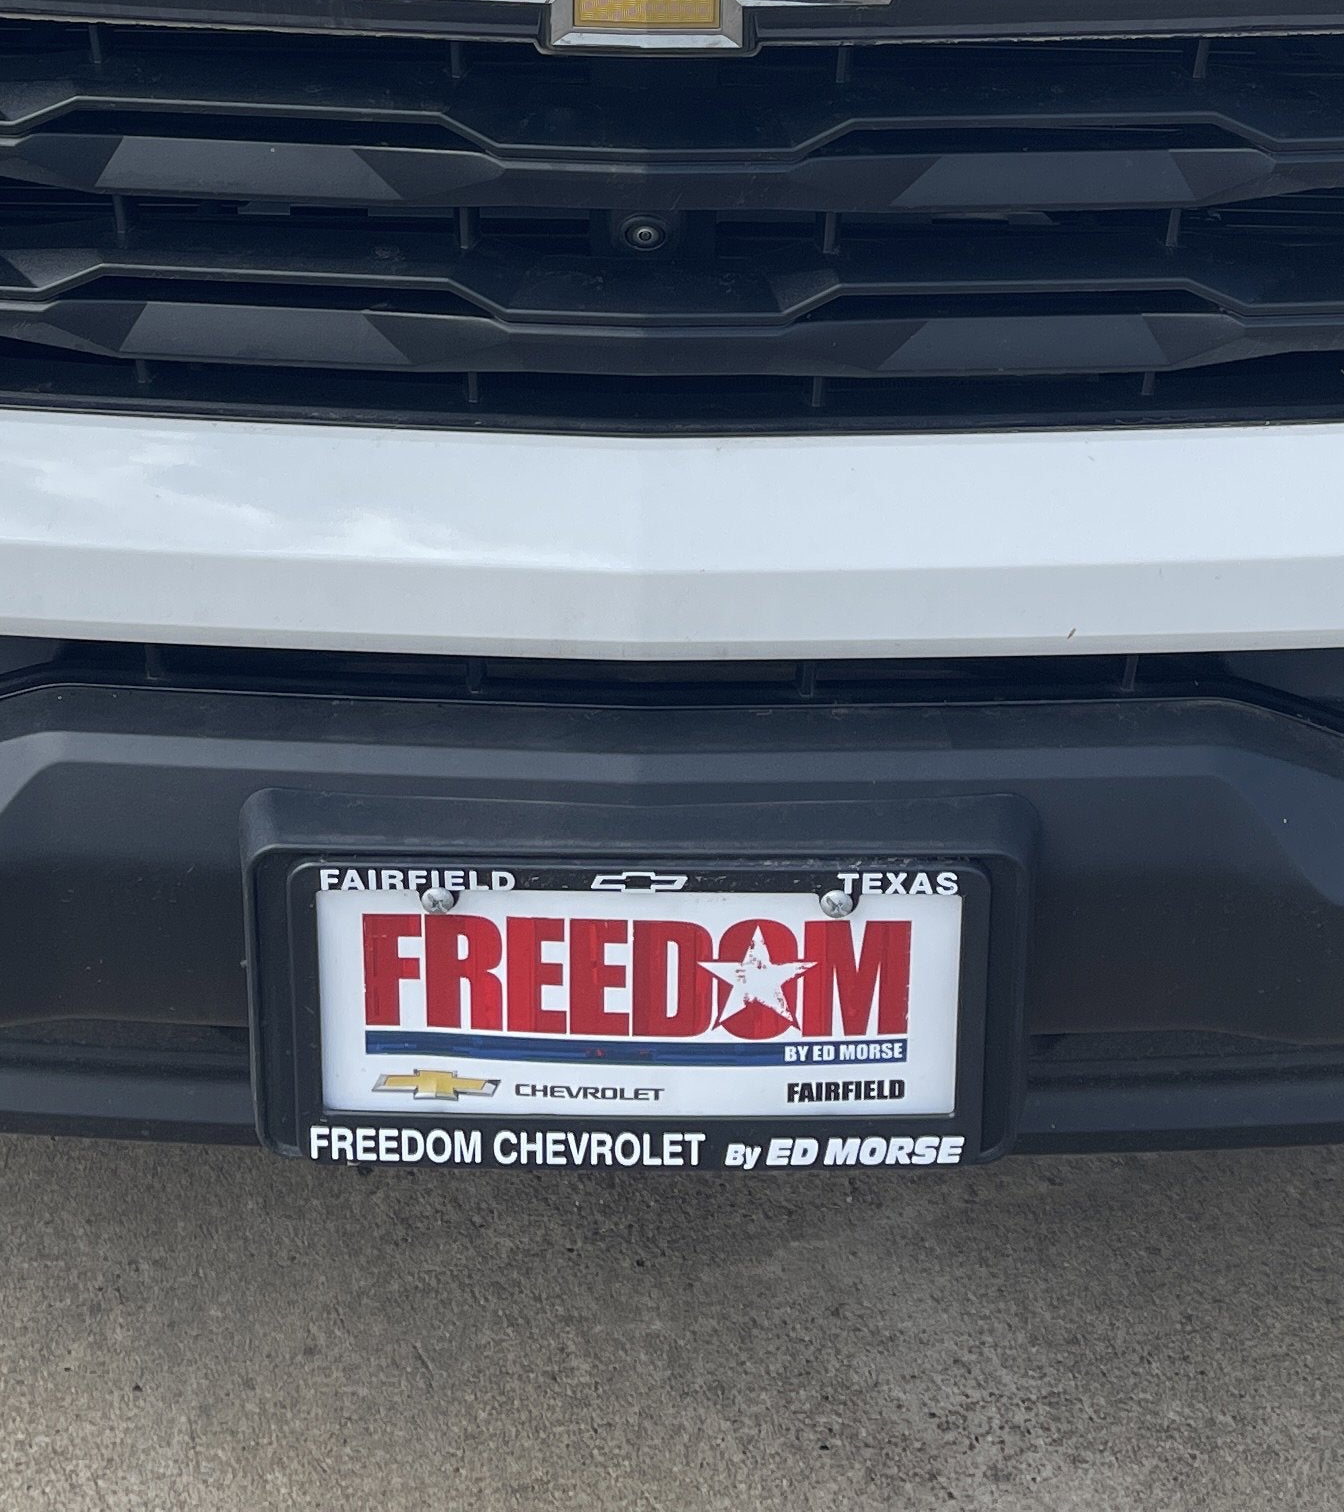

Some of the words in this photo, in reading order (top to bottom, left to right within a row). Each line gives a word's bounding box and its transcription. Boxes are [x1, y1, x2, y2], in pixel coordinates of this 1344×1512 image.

[319, 869, 516, 891] FAIRFIELD
[836, 872, 959, 896] TEXAS
[362, 913, 913, 1040] FREEDOM
[784, 1045, 808, 1063] BY
[812, 1044, 836, 1062] ED
[839, 1042, 903, 1061] MORSE
[515, 1083, 665, 1102] CHEVROLET
[786, 1079, 906, 1104] FAIRFIELD
[309, 1125, 482, 1164] FREEDOM
[493, 1129, 706, 1167] CHEVROLET
[724, 1143, 761, 1170] By
[765, 1137, 819, 1167] ED
[823, 1136, 965, 1166] MORSE
